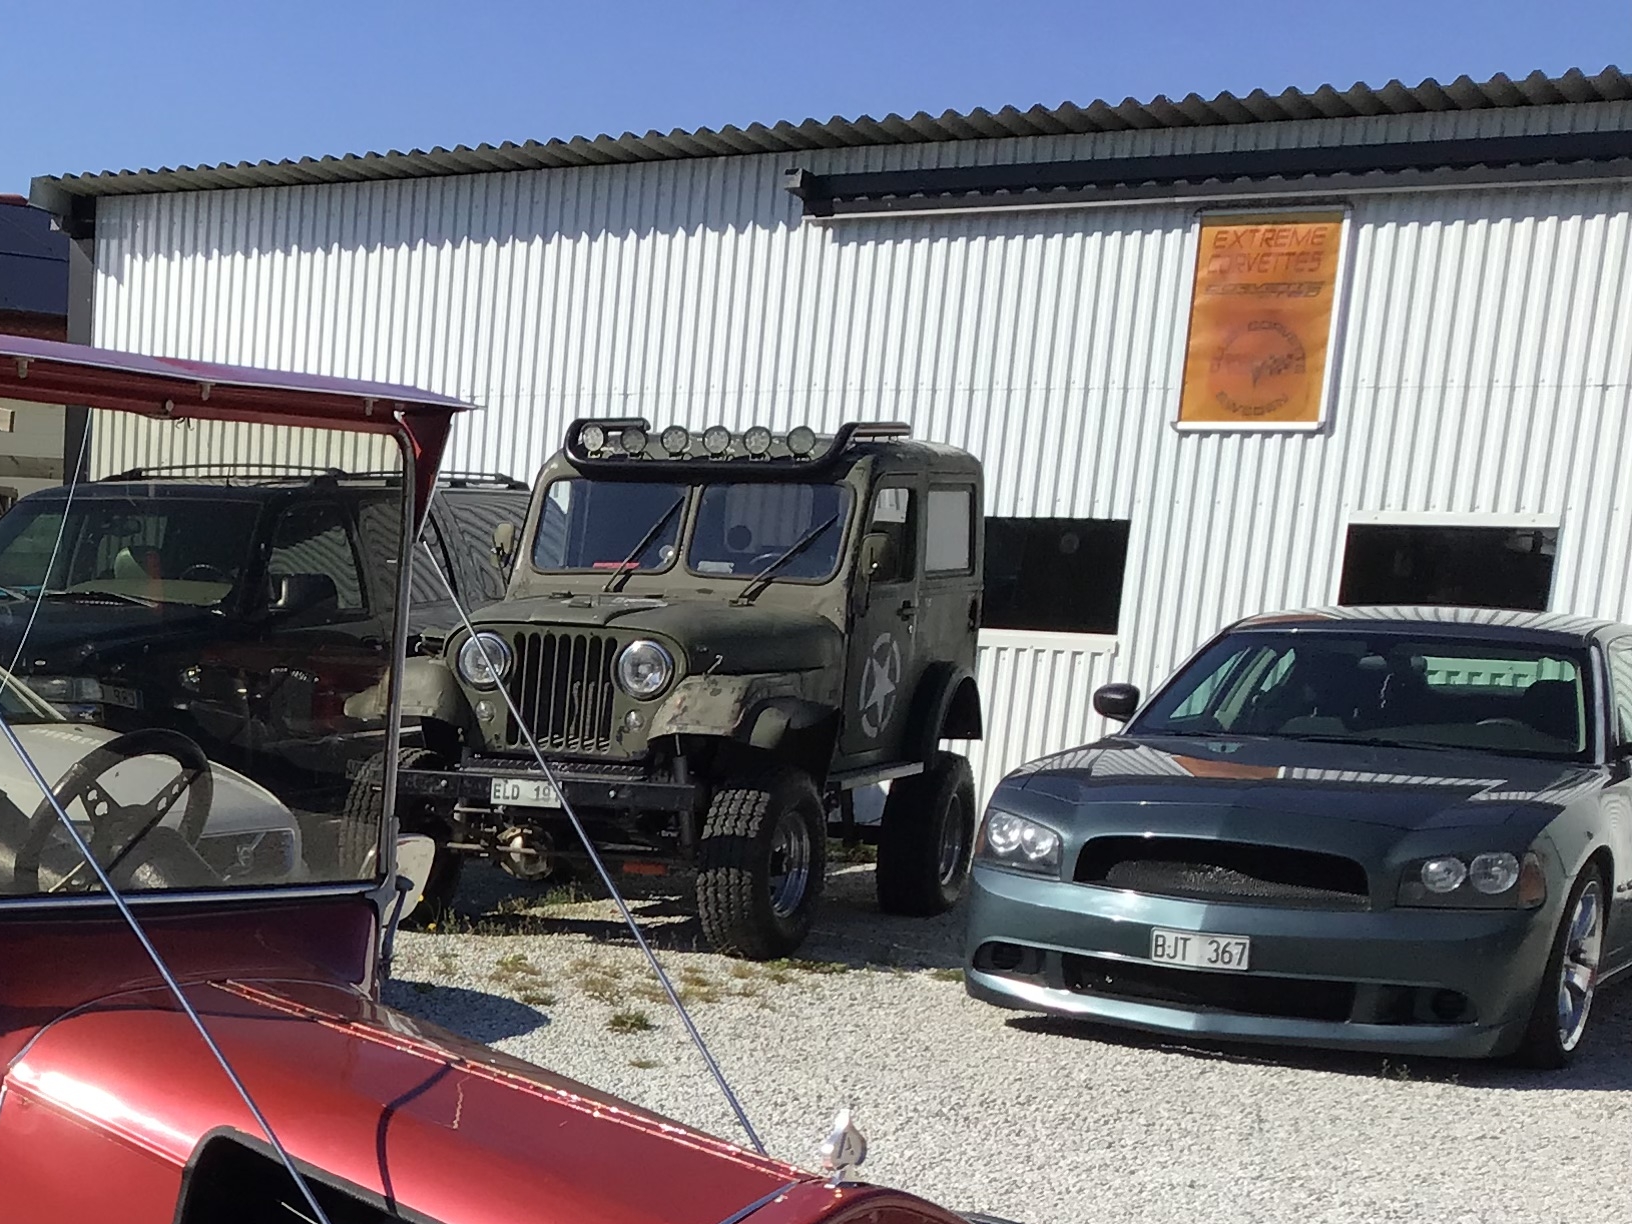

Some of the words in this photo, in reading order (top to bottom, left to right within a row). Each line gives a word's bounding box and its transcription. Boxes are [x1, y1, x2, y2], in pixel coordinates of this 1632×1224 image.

[1213, 226, 1328, 249] EXTREME
[1208, 250, 1325, 273] CORVETTES
[493, 783, 520, 800] ELD
[1154, 934, 1191, 960] BJT
[1207, 939, 1247, 966] 367
